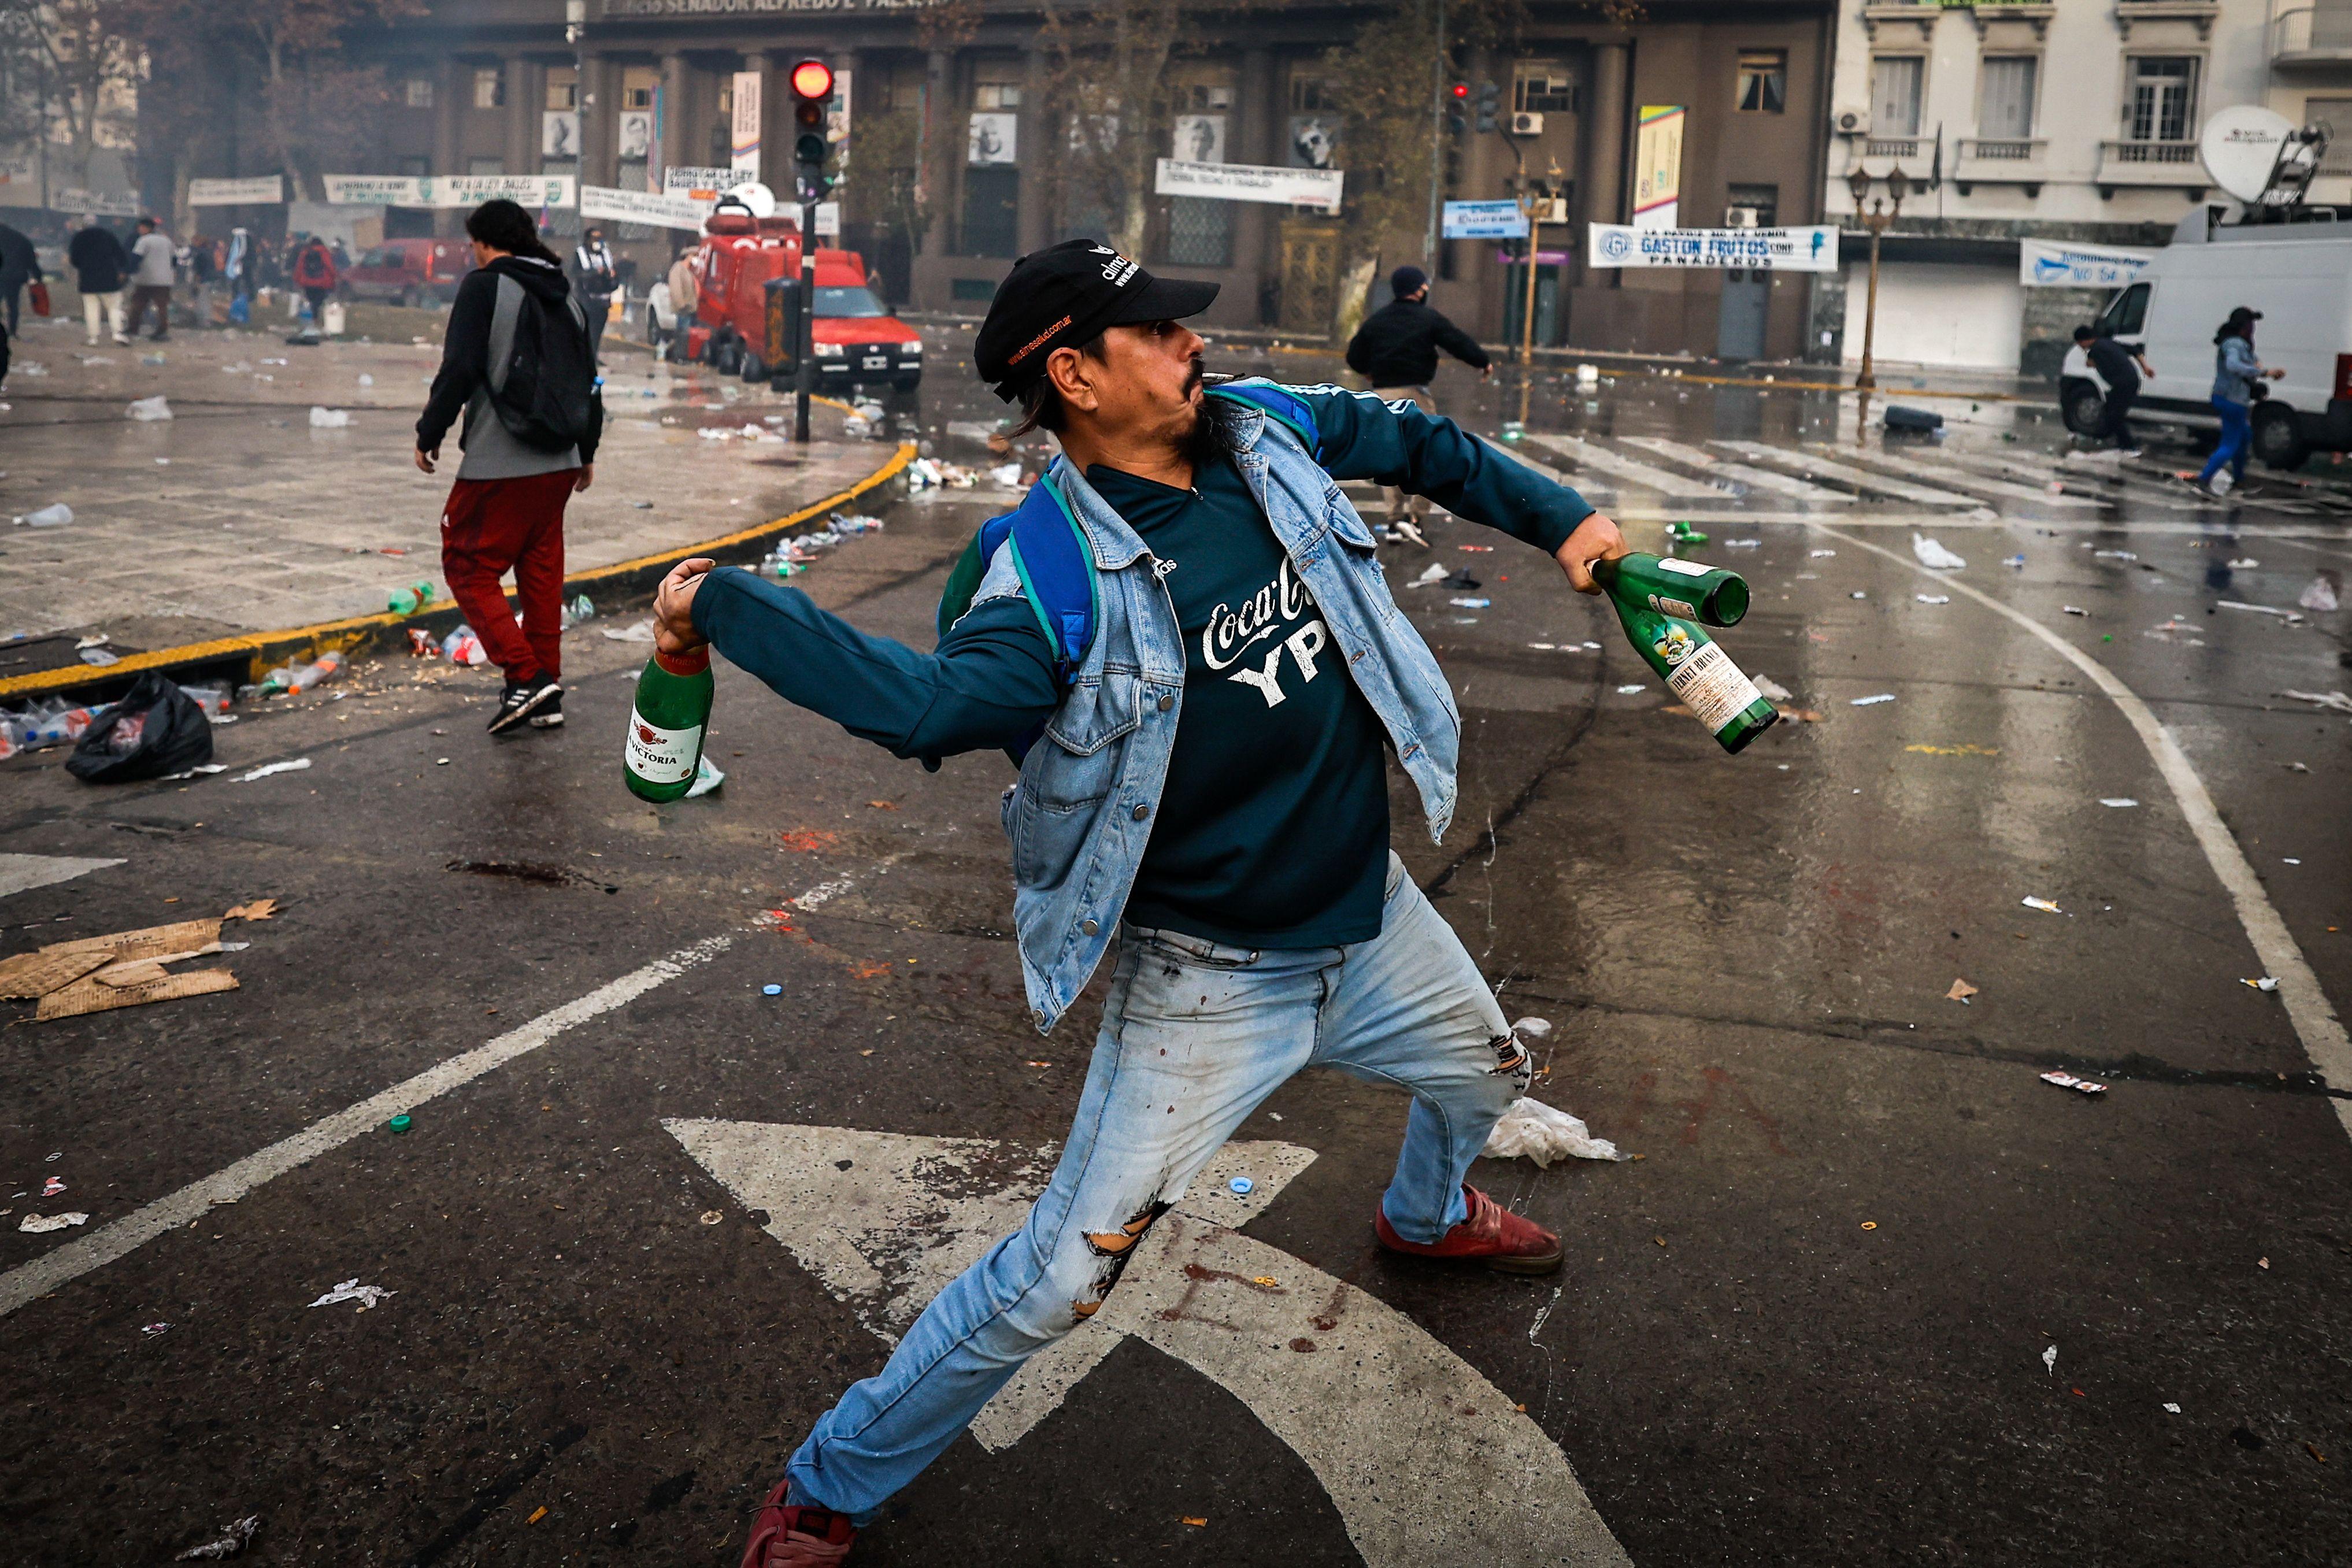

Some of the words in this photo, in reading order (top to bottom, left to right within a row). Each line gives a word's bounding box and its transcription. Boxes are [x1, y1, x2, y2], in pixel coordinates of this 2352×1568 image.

[1642, 238, 1701, 254] GASTON
[1709, 239, 1769, 256] FRUTOS
[1101, 255, 1128, 280] alma
[1650, 255, 1773, 265] PANADEROS
[1008, 315, 1072, 366] www.almasalud.com.ar
[1227, 620, 1327, 709] YP
[1672, 666, 1697, 692] FERNET
[631, 740, 677, 765] VICTORIA
